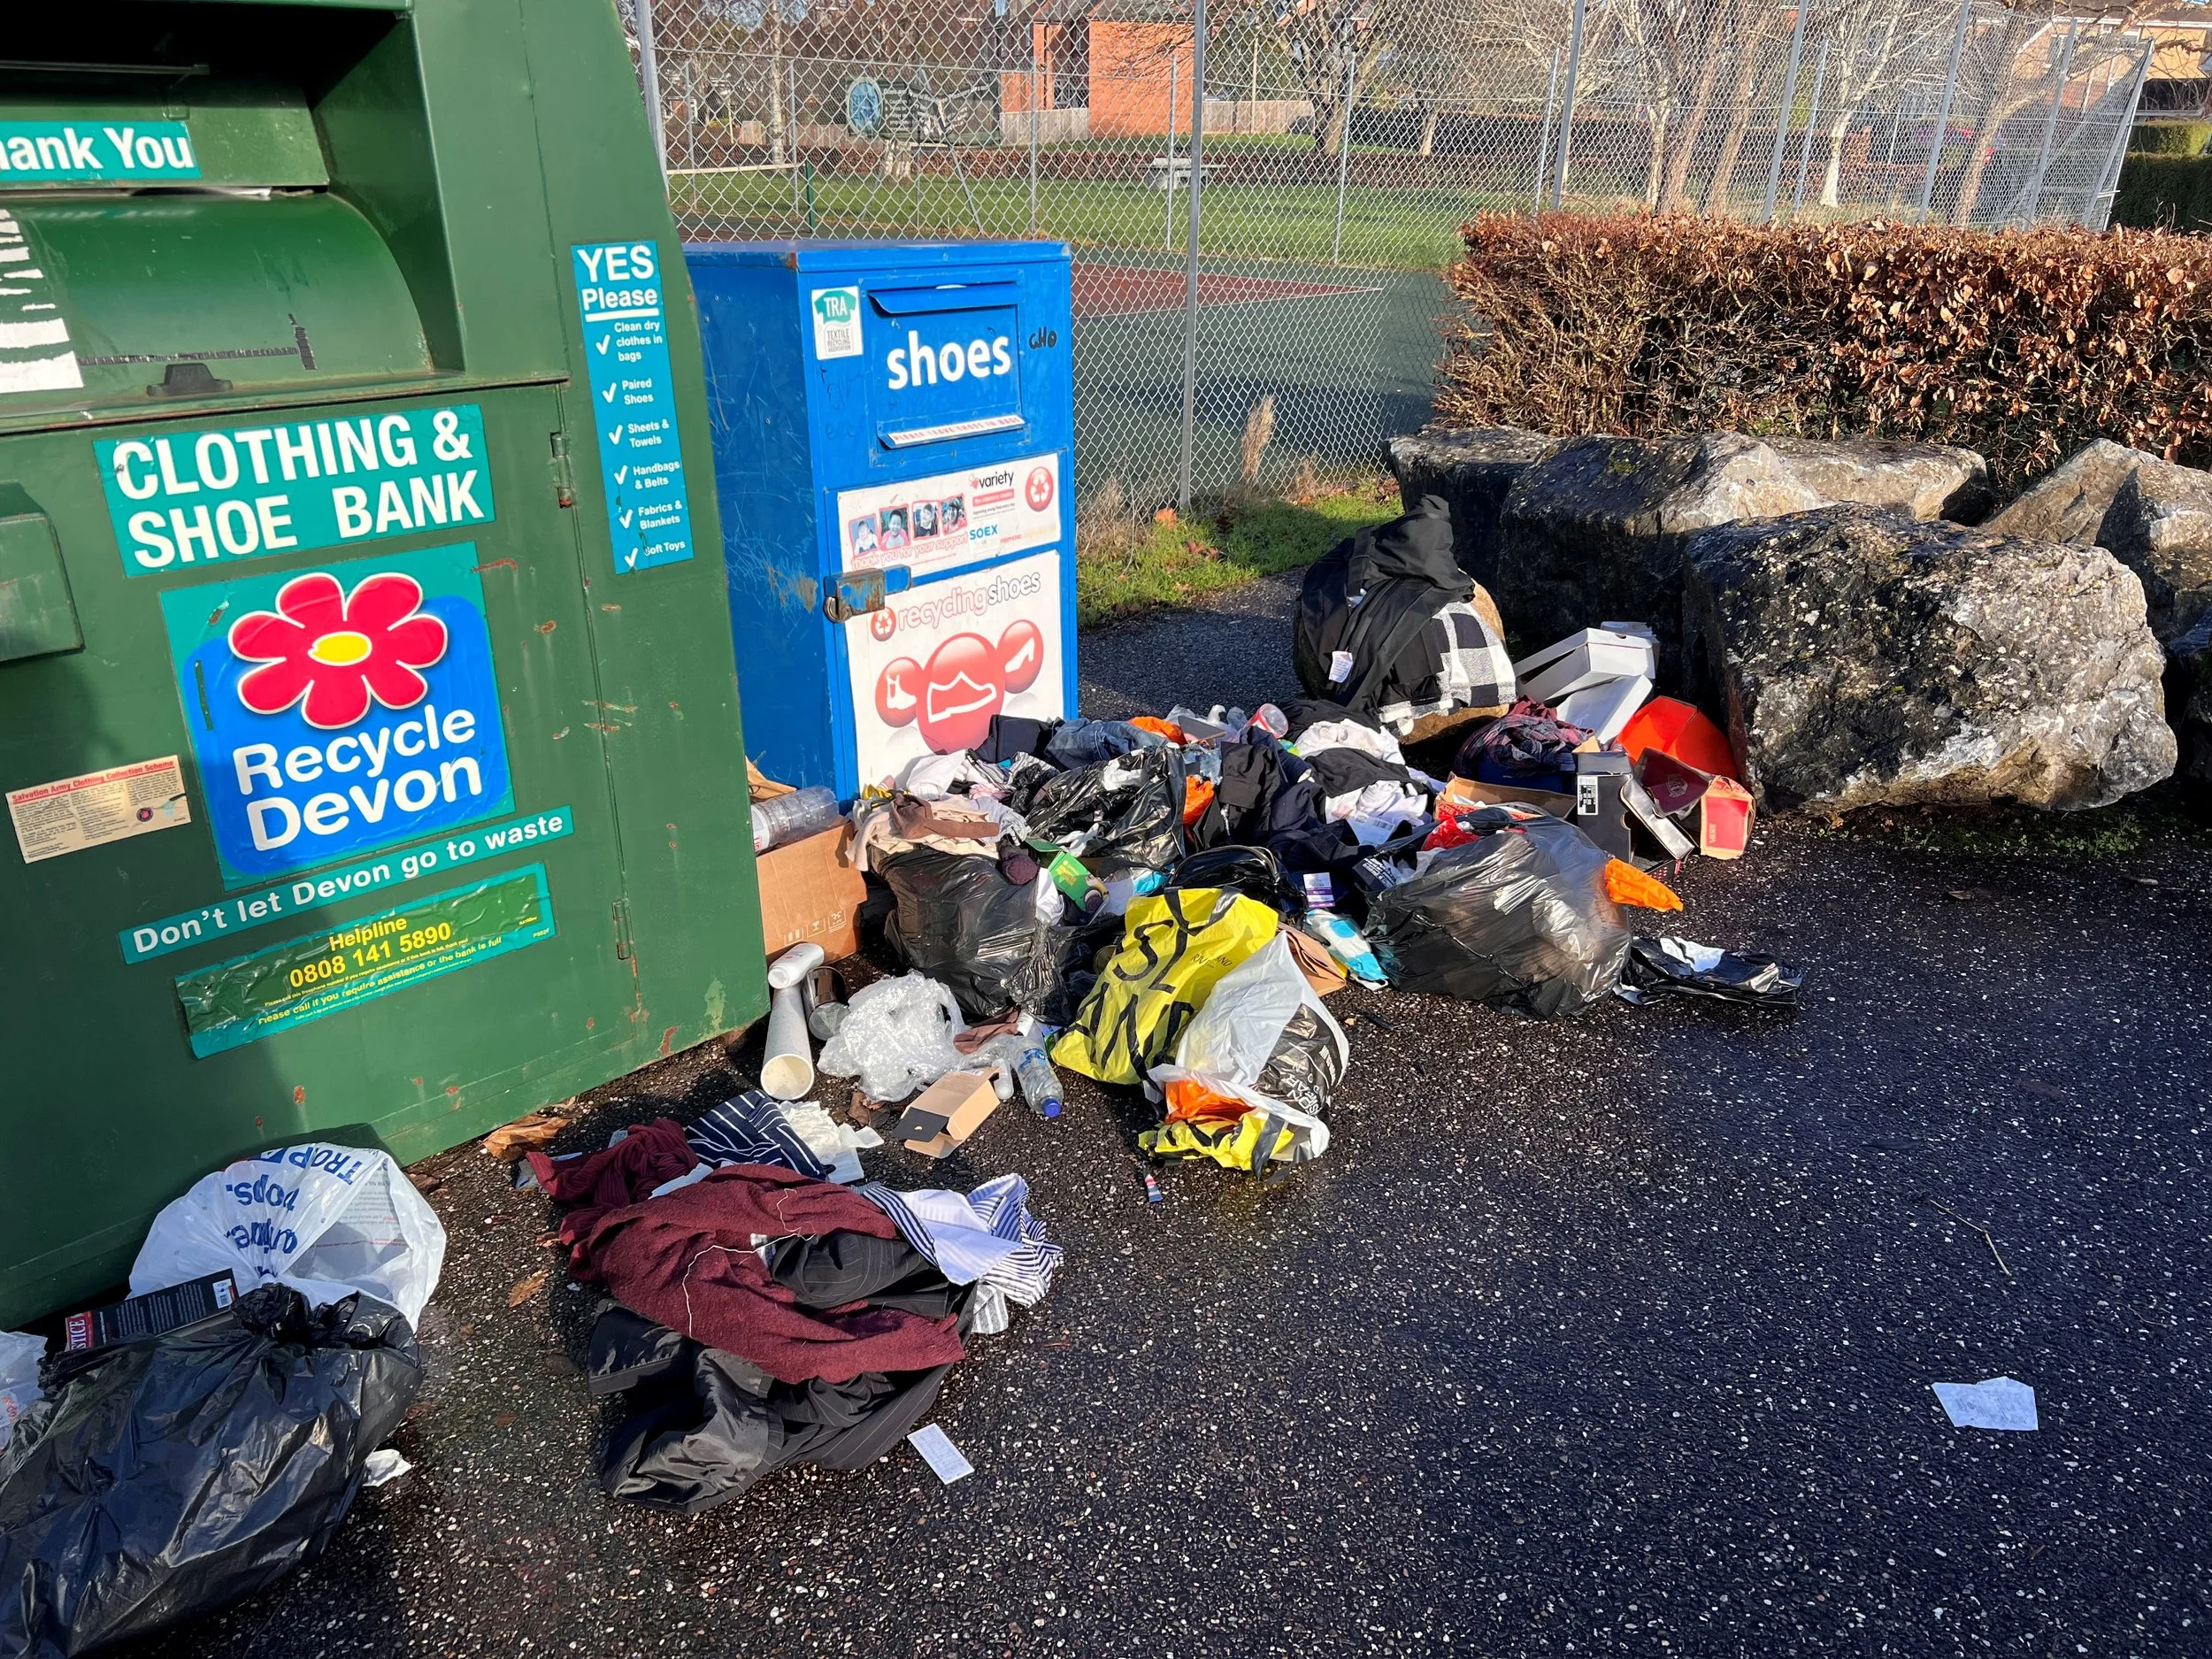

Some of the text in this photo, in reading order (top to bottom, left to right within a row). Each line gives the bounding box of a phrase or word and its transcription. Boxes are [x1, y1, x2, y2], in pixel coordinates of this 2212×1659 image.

[104, 127, 195, 169] You
[577, 244, 655, 282] YES
[581, 288, 657, 311] Please
[824, 296, 848, 318] TRA
[614, 320, 660, 333] Clean dry
[826, 328, 849, 340] TEXTILE
[616, 334, 663, 347] clothes in
[618, 351, 642, 363] bags
[887, 330, 1011, 389] shoes
[622, 378, 652, 390] Paired
[624, 395, 654, 405] Shoes
[627, 419, 670, 434] Sheets &
[629, 435, 662, 448] Towels
[112, 411, 473, 500] CLOTHING &
[633, 460, 680, 476] Handbags
[635, 476, 669, 489] & Belts
[979, 471, 1014, 488] variety
[127, 470, 484, 568] SHOE BANK
[638, 501, 682, 516] Fabrics &
[640, 515, 680, 530] Blankets
[969, 524, 998, 540] SOEX
[644, 540, 686, 556] Soft Toys
[851, 552, 879, 571] thank
[879, 549, 898, 565] you
[899, 546, 913, 557] for
[913, 542, 935, 558] your
[934, 531, 969, 550] support
[233, 704, 475, 795] Recycle
[12, 760, 174, 802] Salvation Army Clothing Collection Scheme
[246, 757, 482, 851] Devon
[133, 816, 563, 953] Don't let Devon go to waste
[329, 918, 407, 952] Helpline
[290, 922, 451, 987] 0808 141 5890
[326, 978, 344, 987] number
[359, 968, 375, 977] require
[376, 960, 400, 971] assistance
[444, 942, 457, 952] thank
[257, 1010, 290, 1025] Please
[293, 1001, 310, 1013] call
[320, 993, 339, 1006] you
[342, 981, 376, 997] require
[377, 963, 426, 985] assistance
[439, 954, 454, 964] the
[455, 946, 476, 958] bank
[488, 937, 502, 948] full
